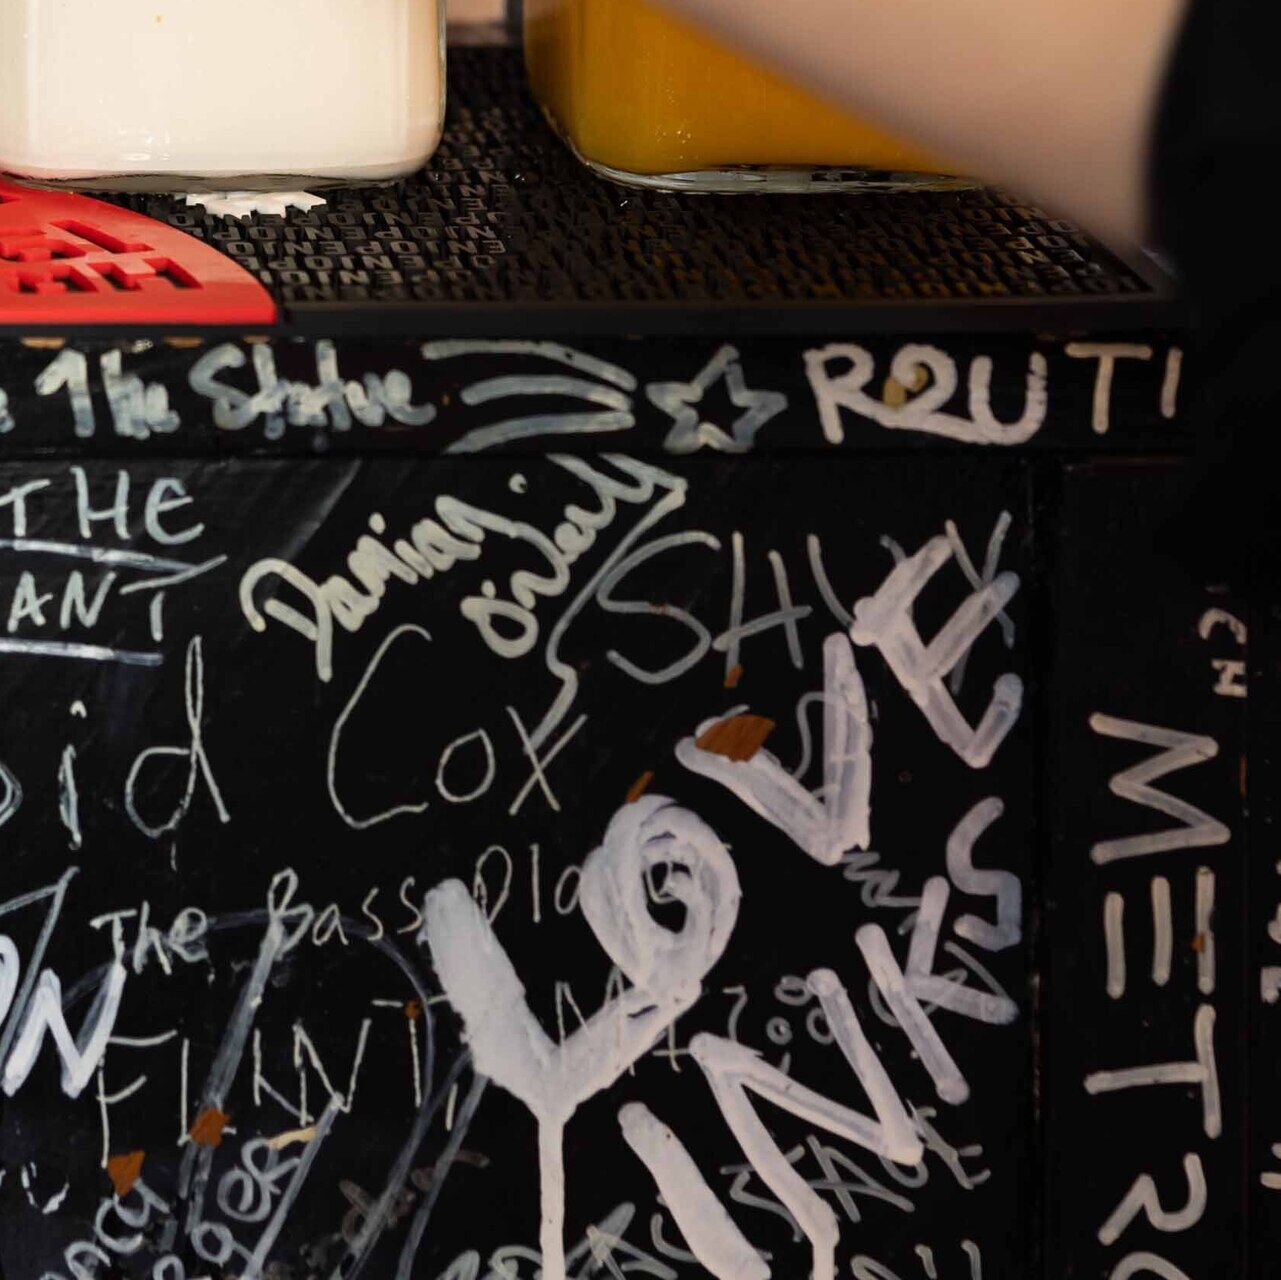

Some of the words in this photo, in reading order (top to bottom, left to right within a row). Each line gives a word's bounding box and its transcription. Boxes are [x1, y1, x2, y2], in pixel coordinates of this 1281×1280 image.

[328, 624, 588, 831] Cox
[89, 899, 214, 980] The
[265, 866, 425, 965] Bass
